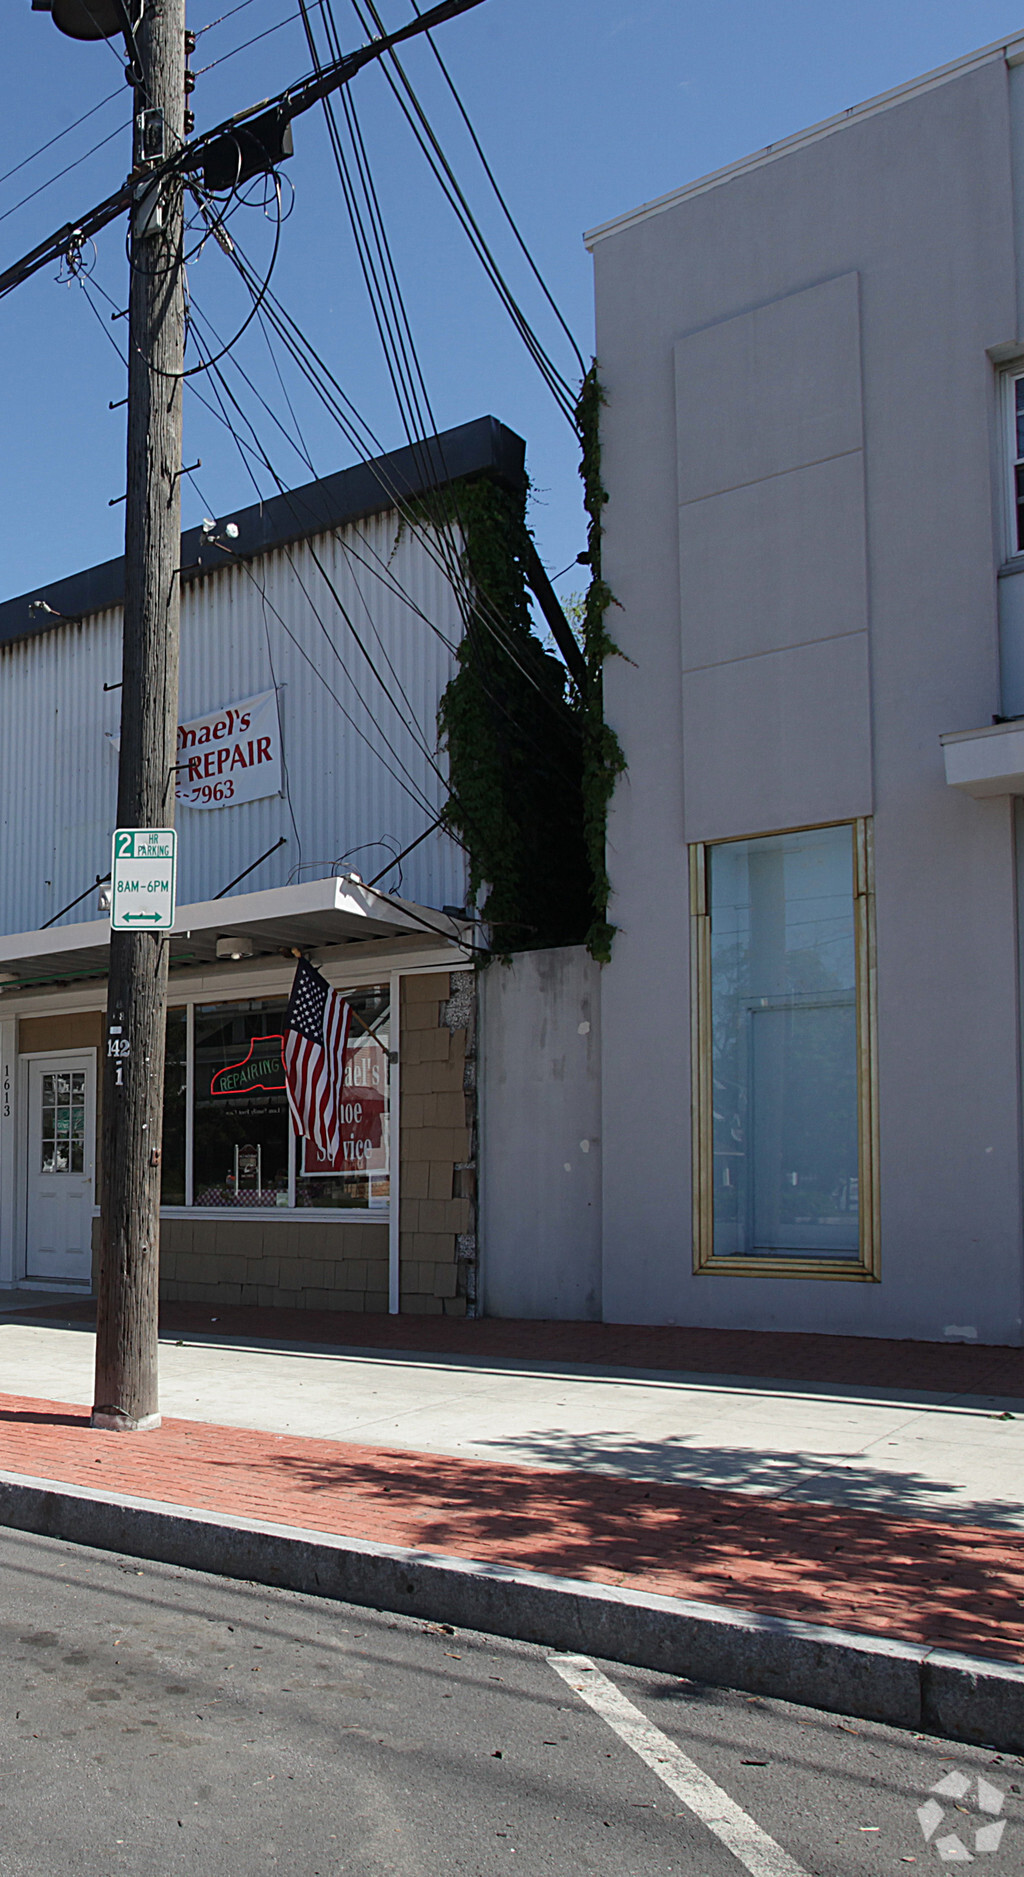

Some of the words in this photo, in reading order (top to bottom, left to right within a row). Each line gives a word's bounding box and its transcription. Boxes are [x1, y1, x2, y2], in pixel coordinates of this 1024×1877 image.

[188, 736, 273, 782] REPAIR
[119, 834, 133, 857] 2
[137, 844, 170, 857] PARKING
[148, 834, 160, 845] HR
[107, 1039, 131, 1057] 142
[219, 1058, 280, 1092] REPAIRING
[344, 1057, 380, 1088] ael's
[316, 1132, 373, 1163] Sevice
